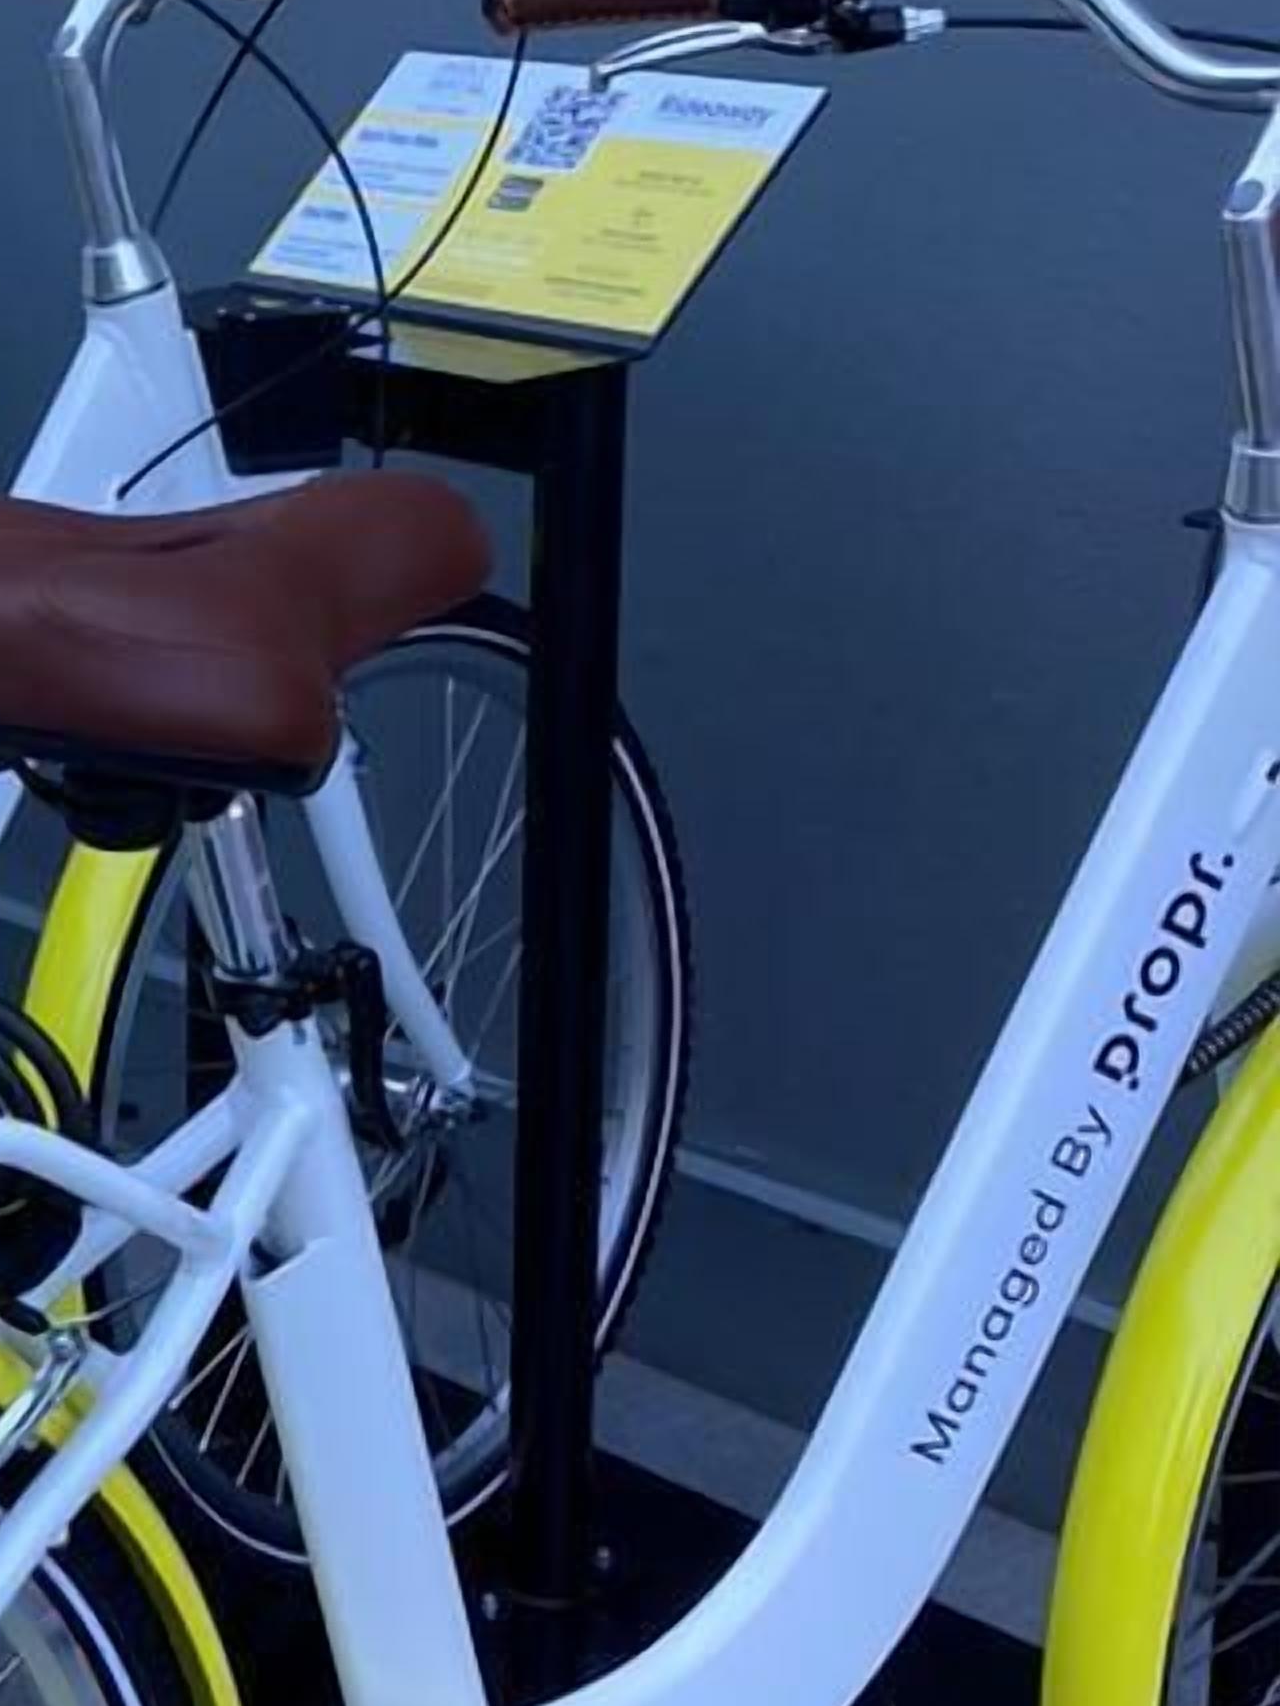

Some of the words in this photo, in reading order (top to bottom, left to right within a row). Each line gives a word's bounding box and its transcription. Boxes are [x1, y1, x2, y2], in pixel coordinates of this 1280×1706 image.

[907, 1189, 1069, 1467] Managed
[1053, 1103, 1113, 1182] By
[1092, 849, 1237, 1094] propr.
